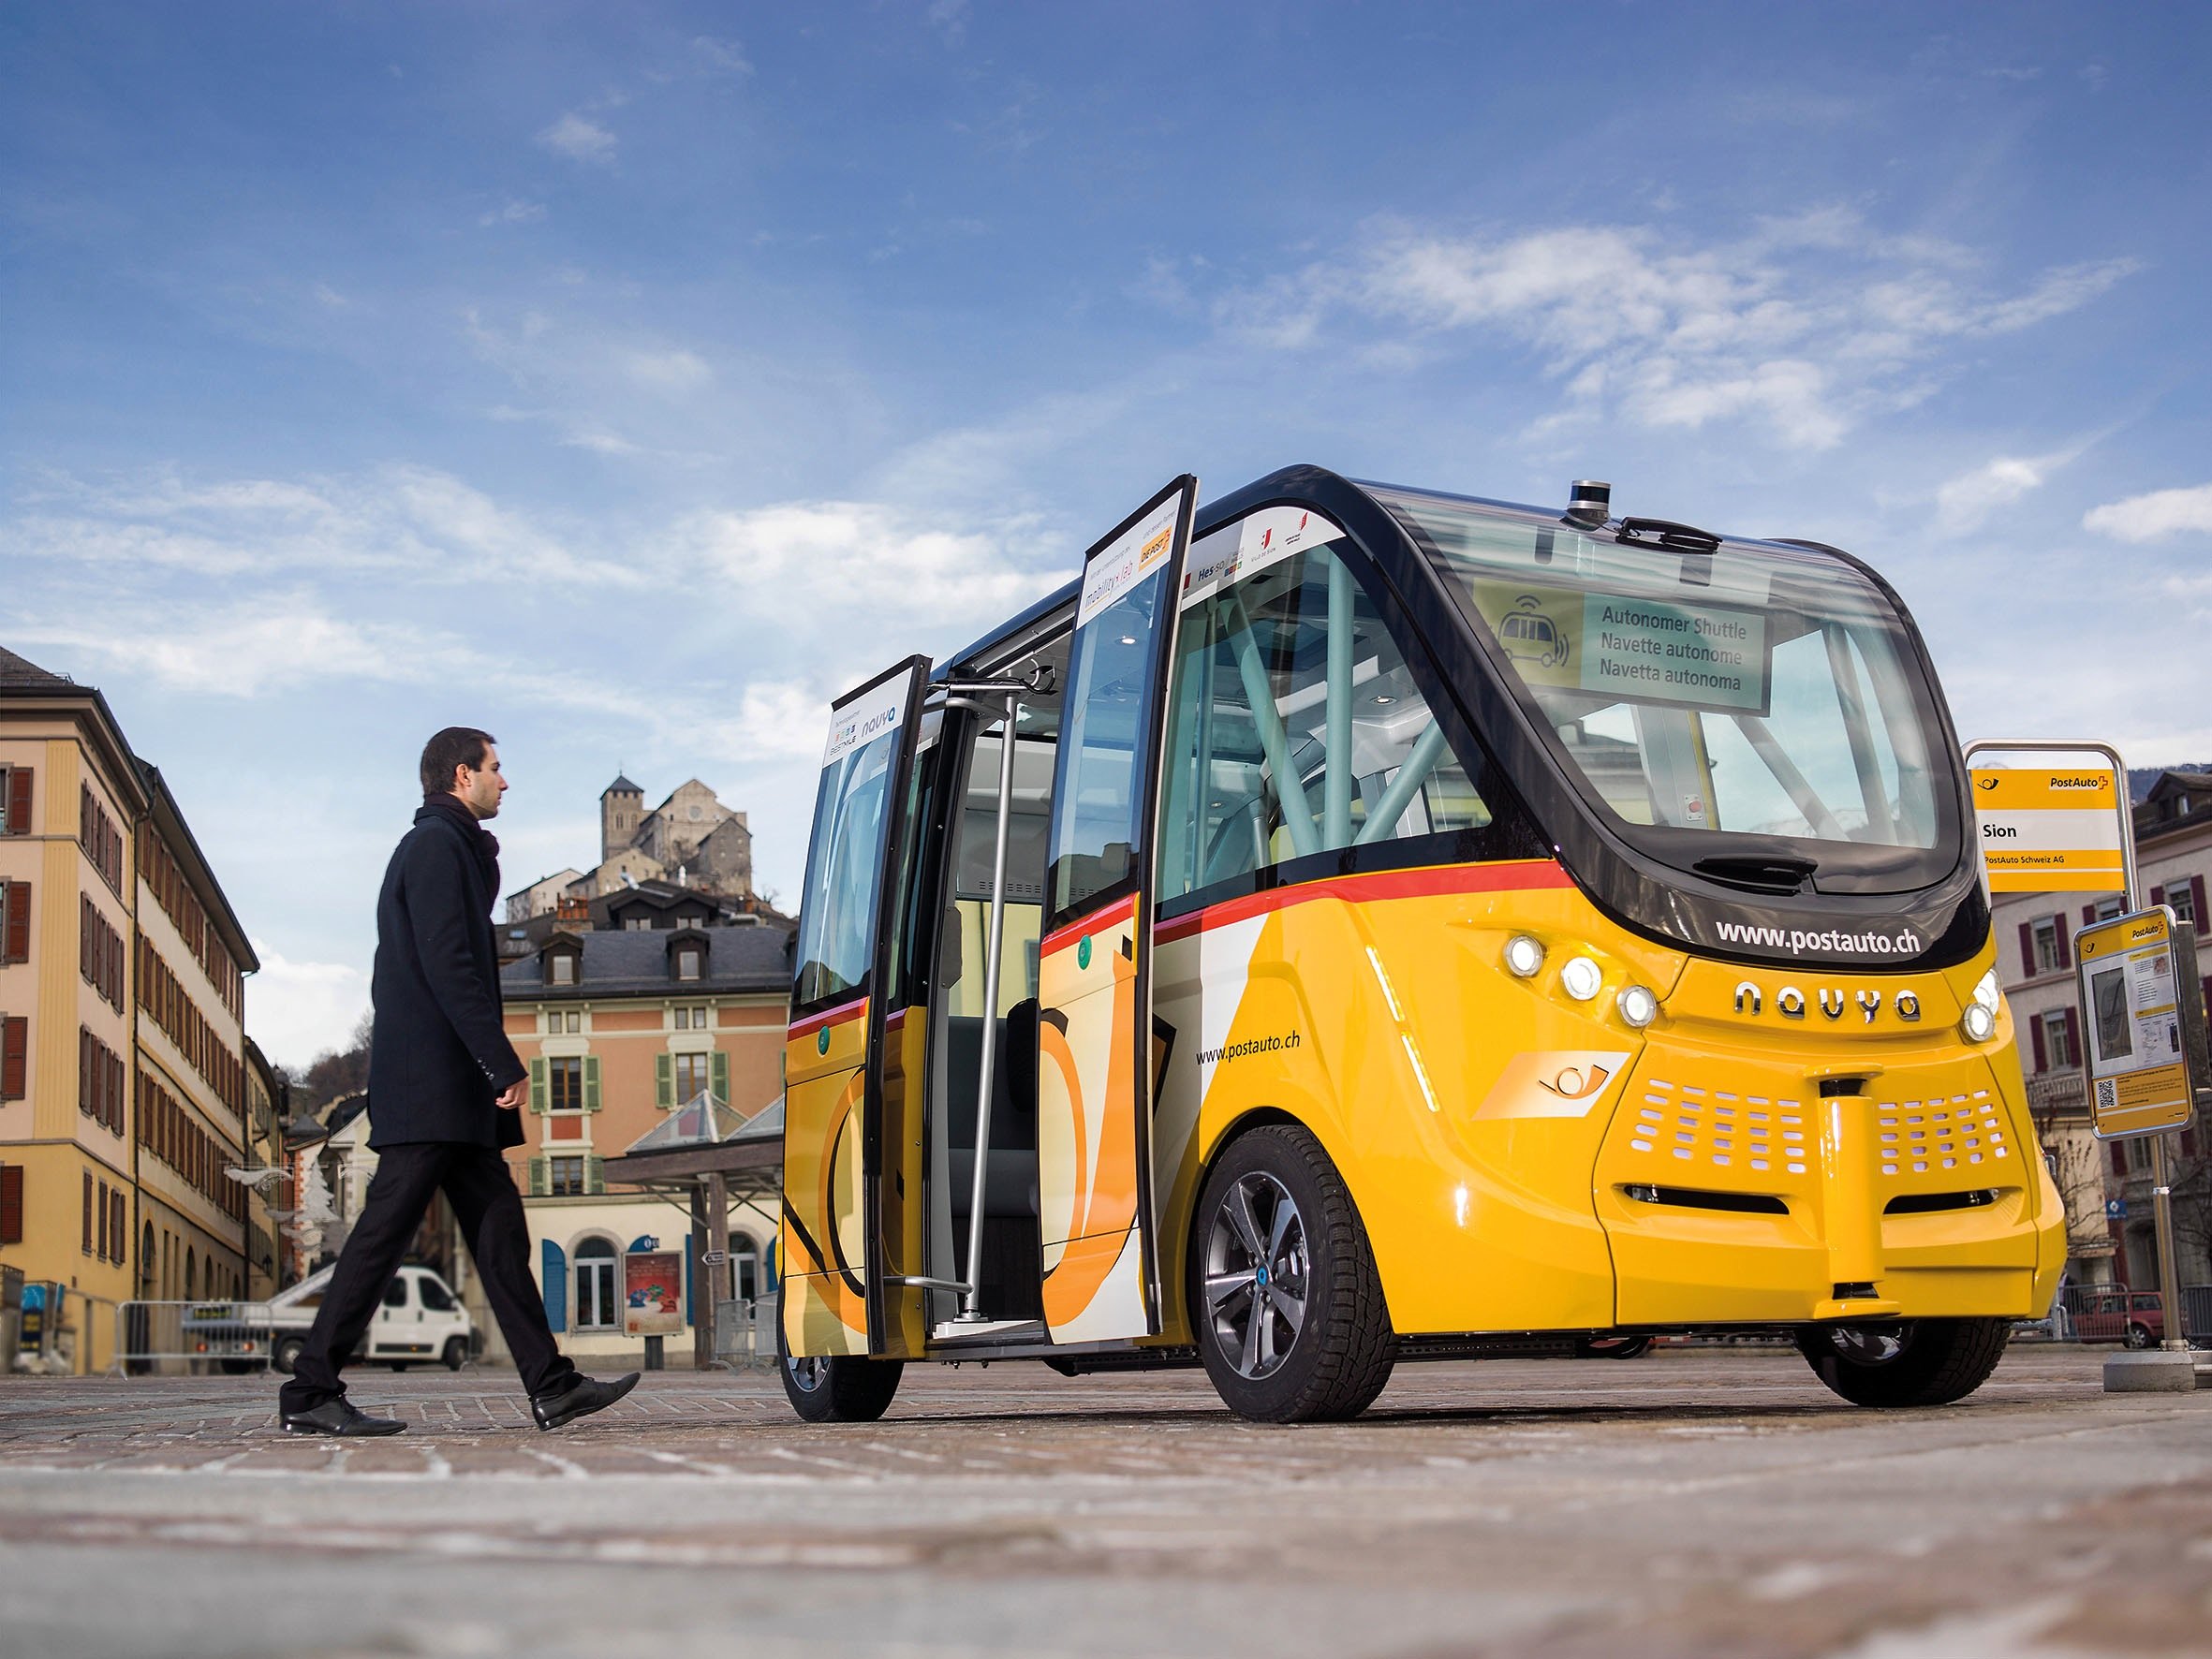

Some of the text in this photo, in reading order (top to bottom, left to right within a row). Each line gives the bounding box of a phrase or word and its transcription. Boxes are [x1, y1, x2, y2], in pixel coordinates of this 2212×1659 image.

[1085, 577, 1113, 609] mobility
[1602, 606, 1747, 640] Autonomer Shuttle
[1601, 632, 1742, 665] Navette autonome
[1600, 658, 1741, 691] Navetta autonoma
[2050, 777, 2098, 787] PostAuto
[1983, 824, 2017, 837] Sion
[2021, 856, 2051, 864] Schweiz
[1716, 921, 1921, 955] www.postauto.ch
[2132, 925, 2159, 938] PostAuto
[1196, 1030, 1301, 1065] www.postauto.ch
